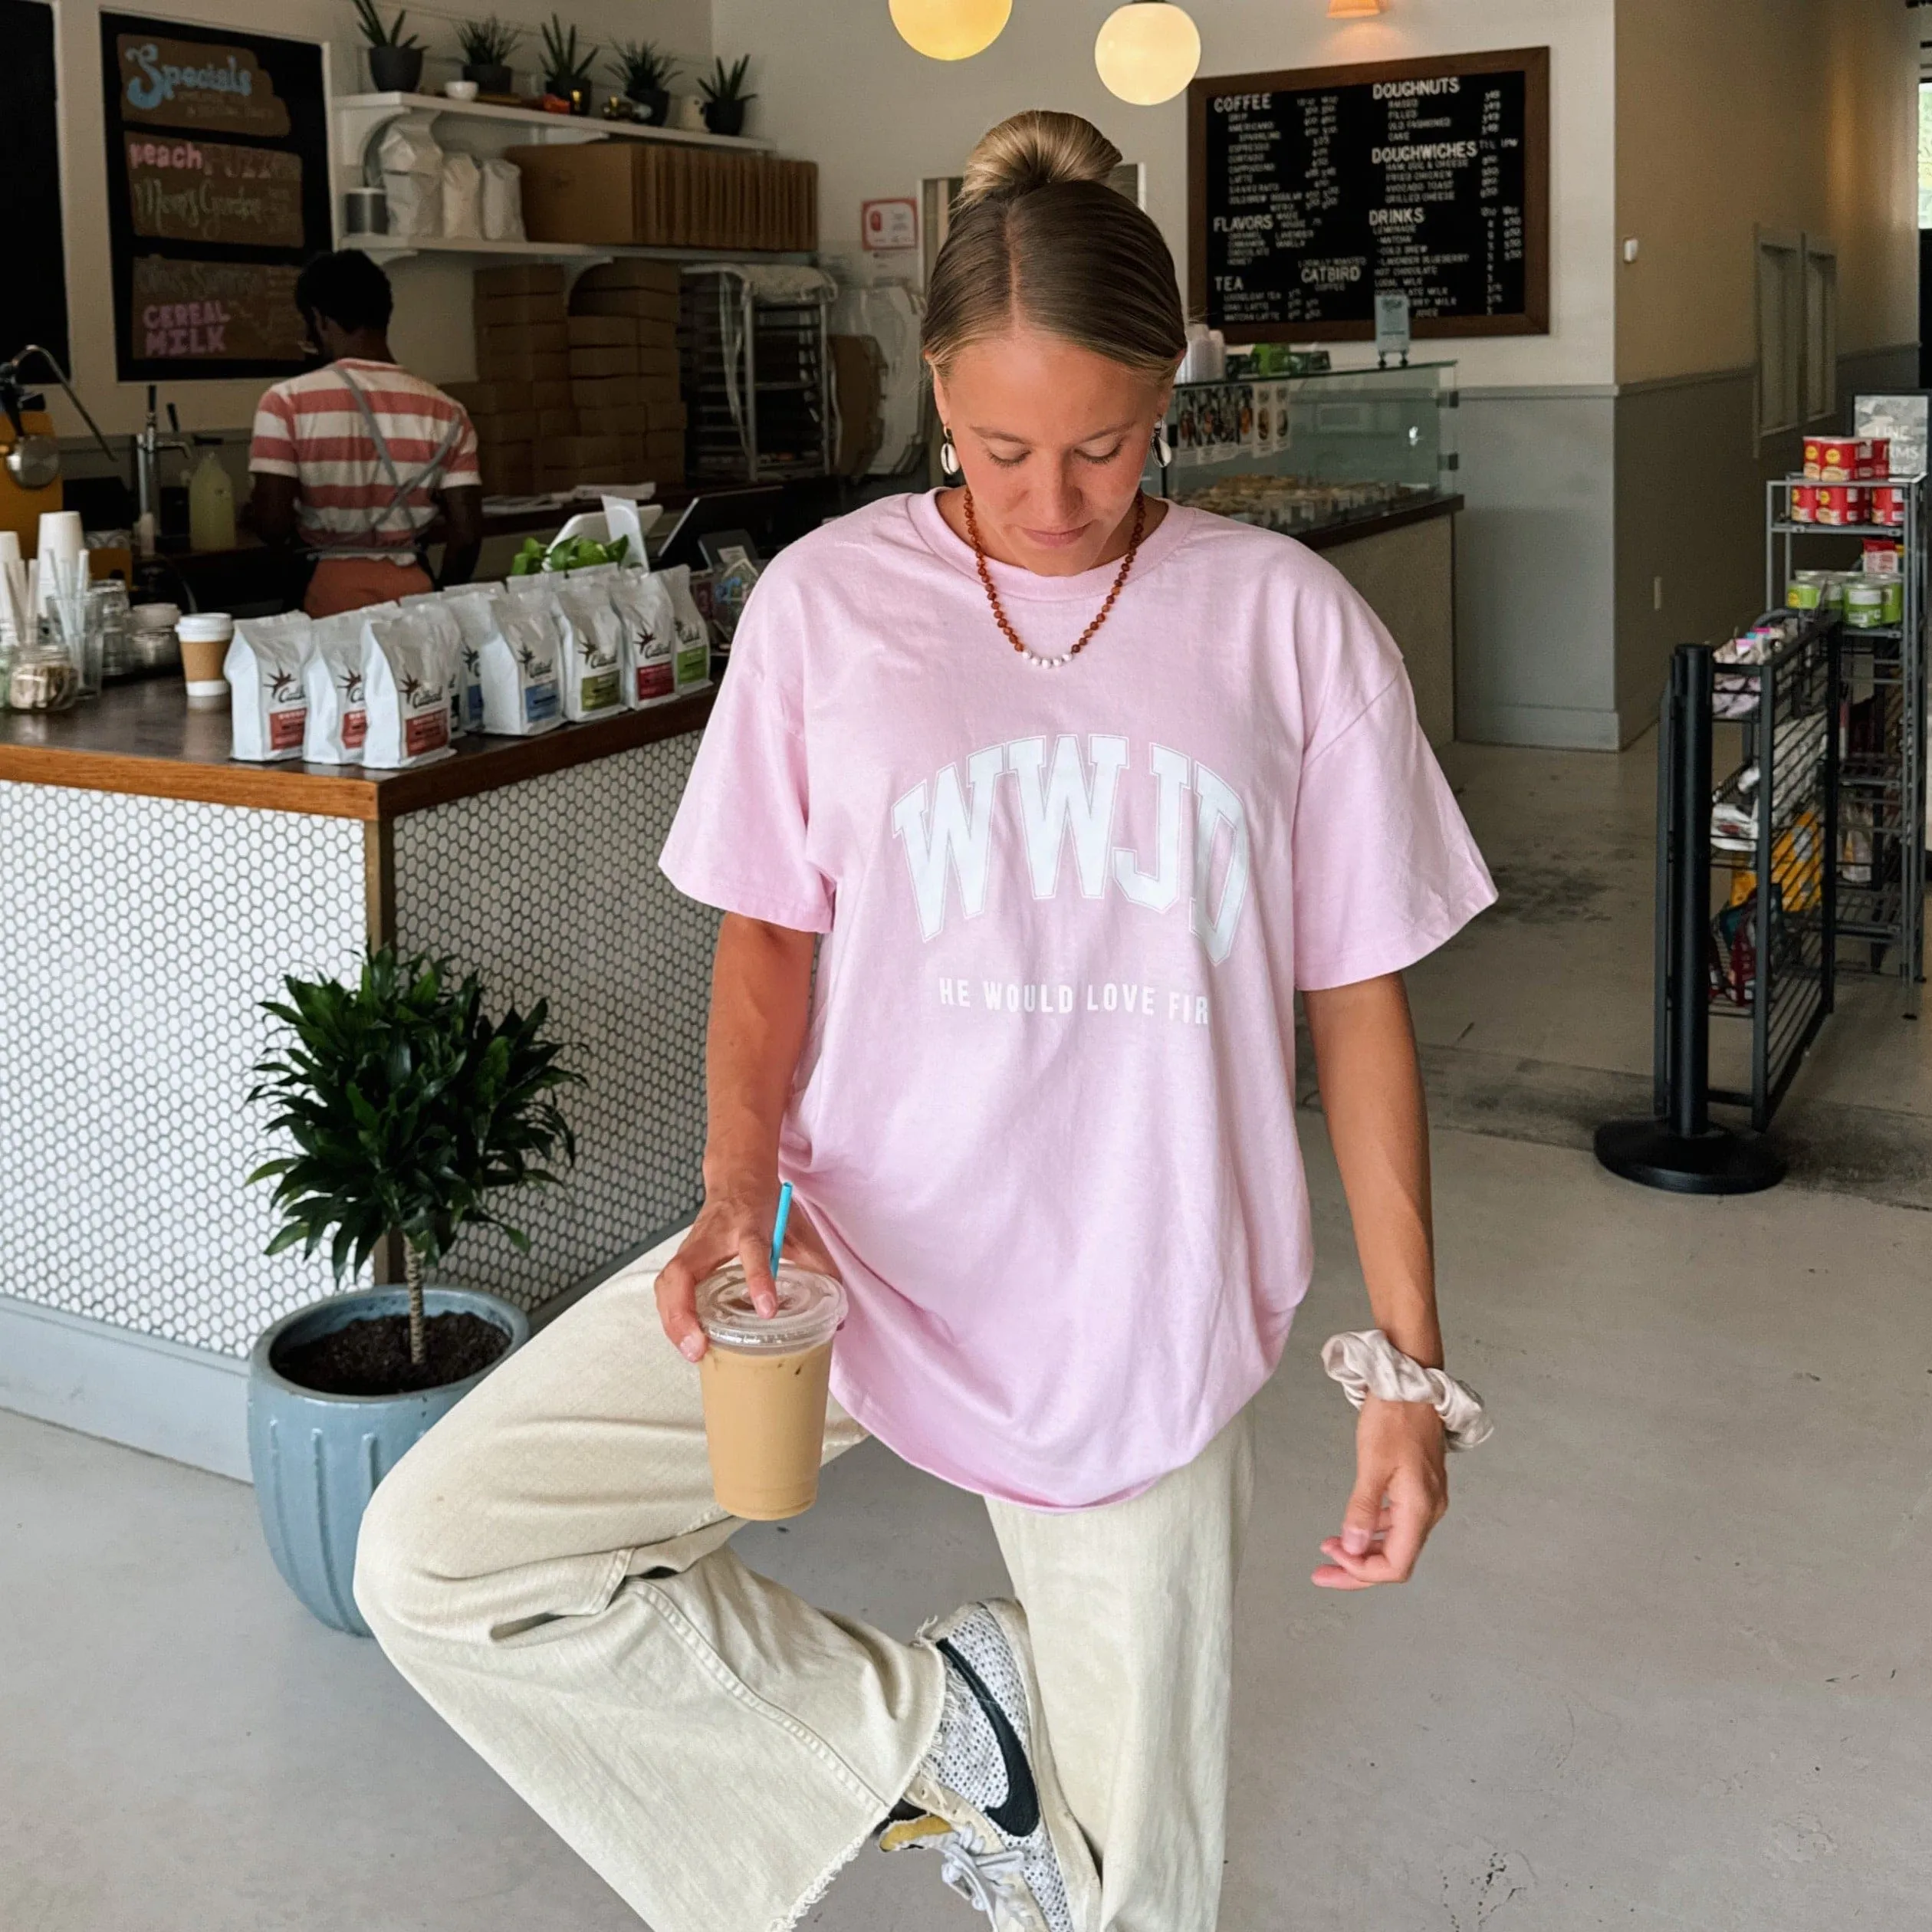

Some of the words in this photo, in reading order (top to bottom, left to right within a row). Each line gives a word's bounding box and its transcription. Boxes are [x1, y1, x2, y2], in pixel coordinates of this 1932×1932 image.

[126, 43, 252, 110] Specials
[1372, 77, 1460, 100] DOUGHNUTS
[1214, 93, 1272, 113] COFFEE
[1372, 140, 1478, 164] DOUGHWICHES
[1214, 214, 1273, 232] FLAVORS
[1368, 206, 1425, 226] DRINKS
[1214, 275, 1244, 292] TEA
[1301, 266, 1362, 284] CATBIRD
[143, 300, 232, 330] CEREAL
[145, 325, 228, 357] MILK
[892, 734, 1250, 966] WWJD
[939, 978, 971, 1007] HE
[983, 981, 1074, 1014] WOULD
[1086, 983, 1155, 1016] LOVE
